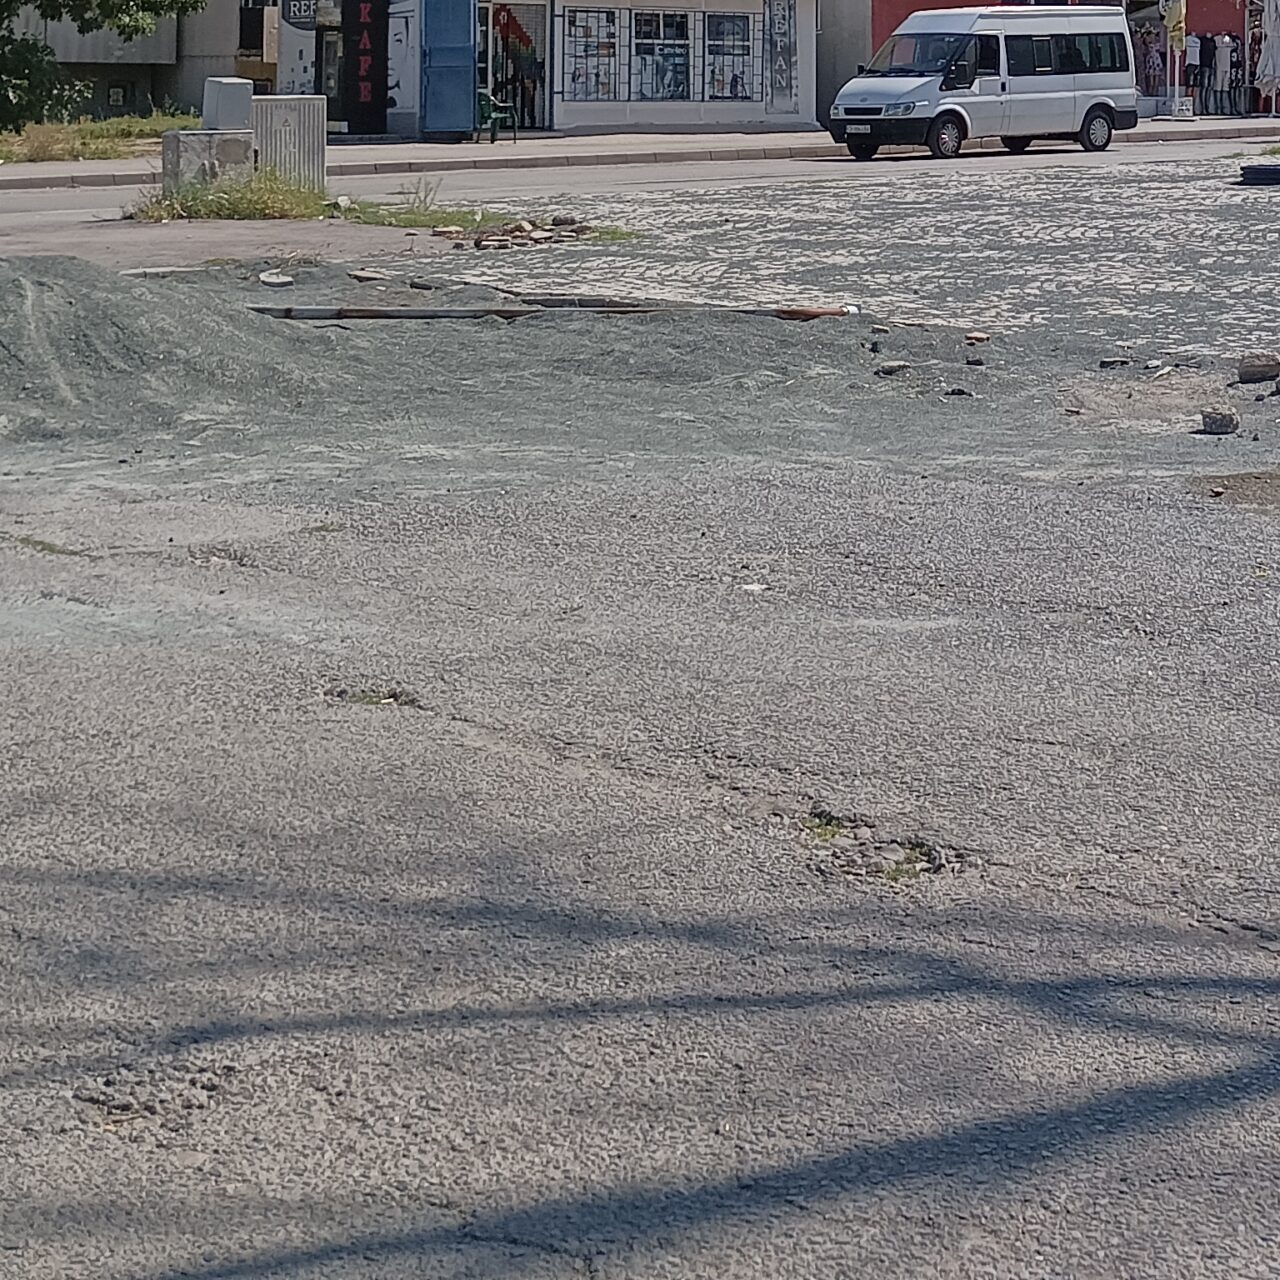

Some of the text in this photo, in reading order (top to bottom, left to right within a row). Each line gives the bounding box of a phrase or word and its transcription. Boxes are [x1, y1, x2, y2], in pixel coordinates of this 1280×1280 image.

[289, 0, 316, 16] REF
[774, 0, 787, 87] REFAN
[359, 3, 372, 102] KAFE
